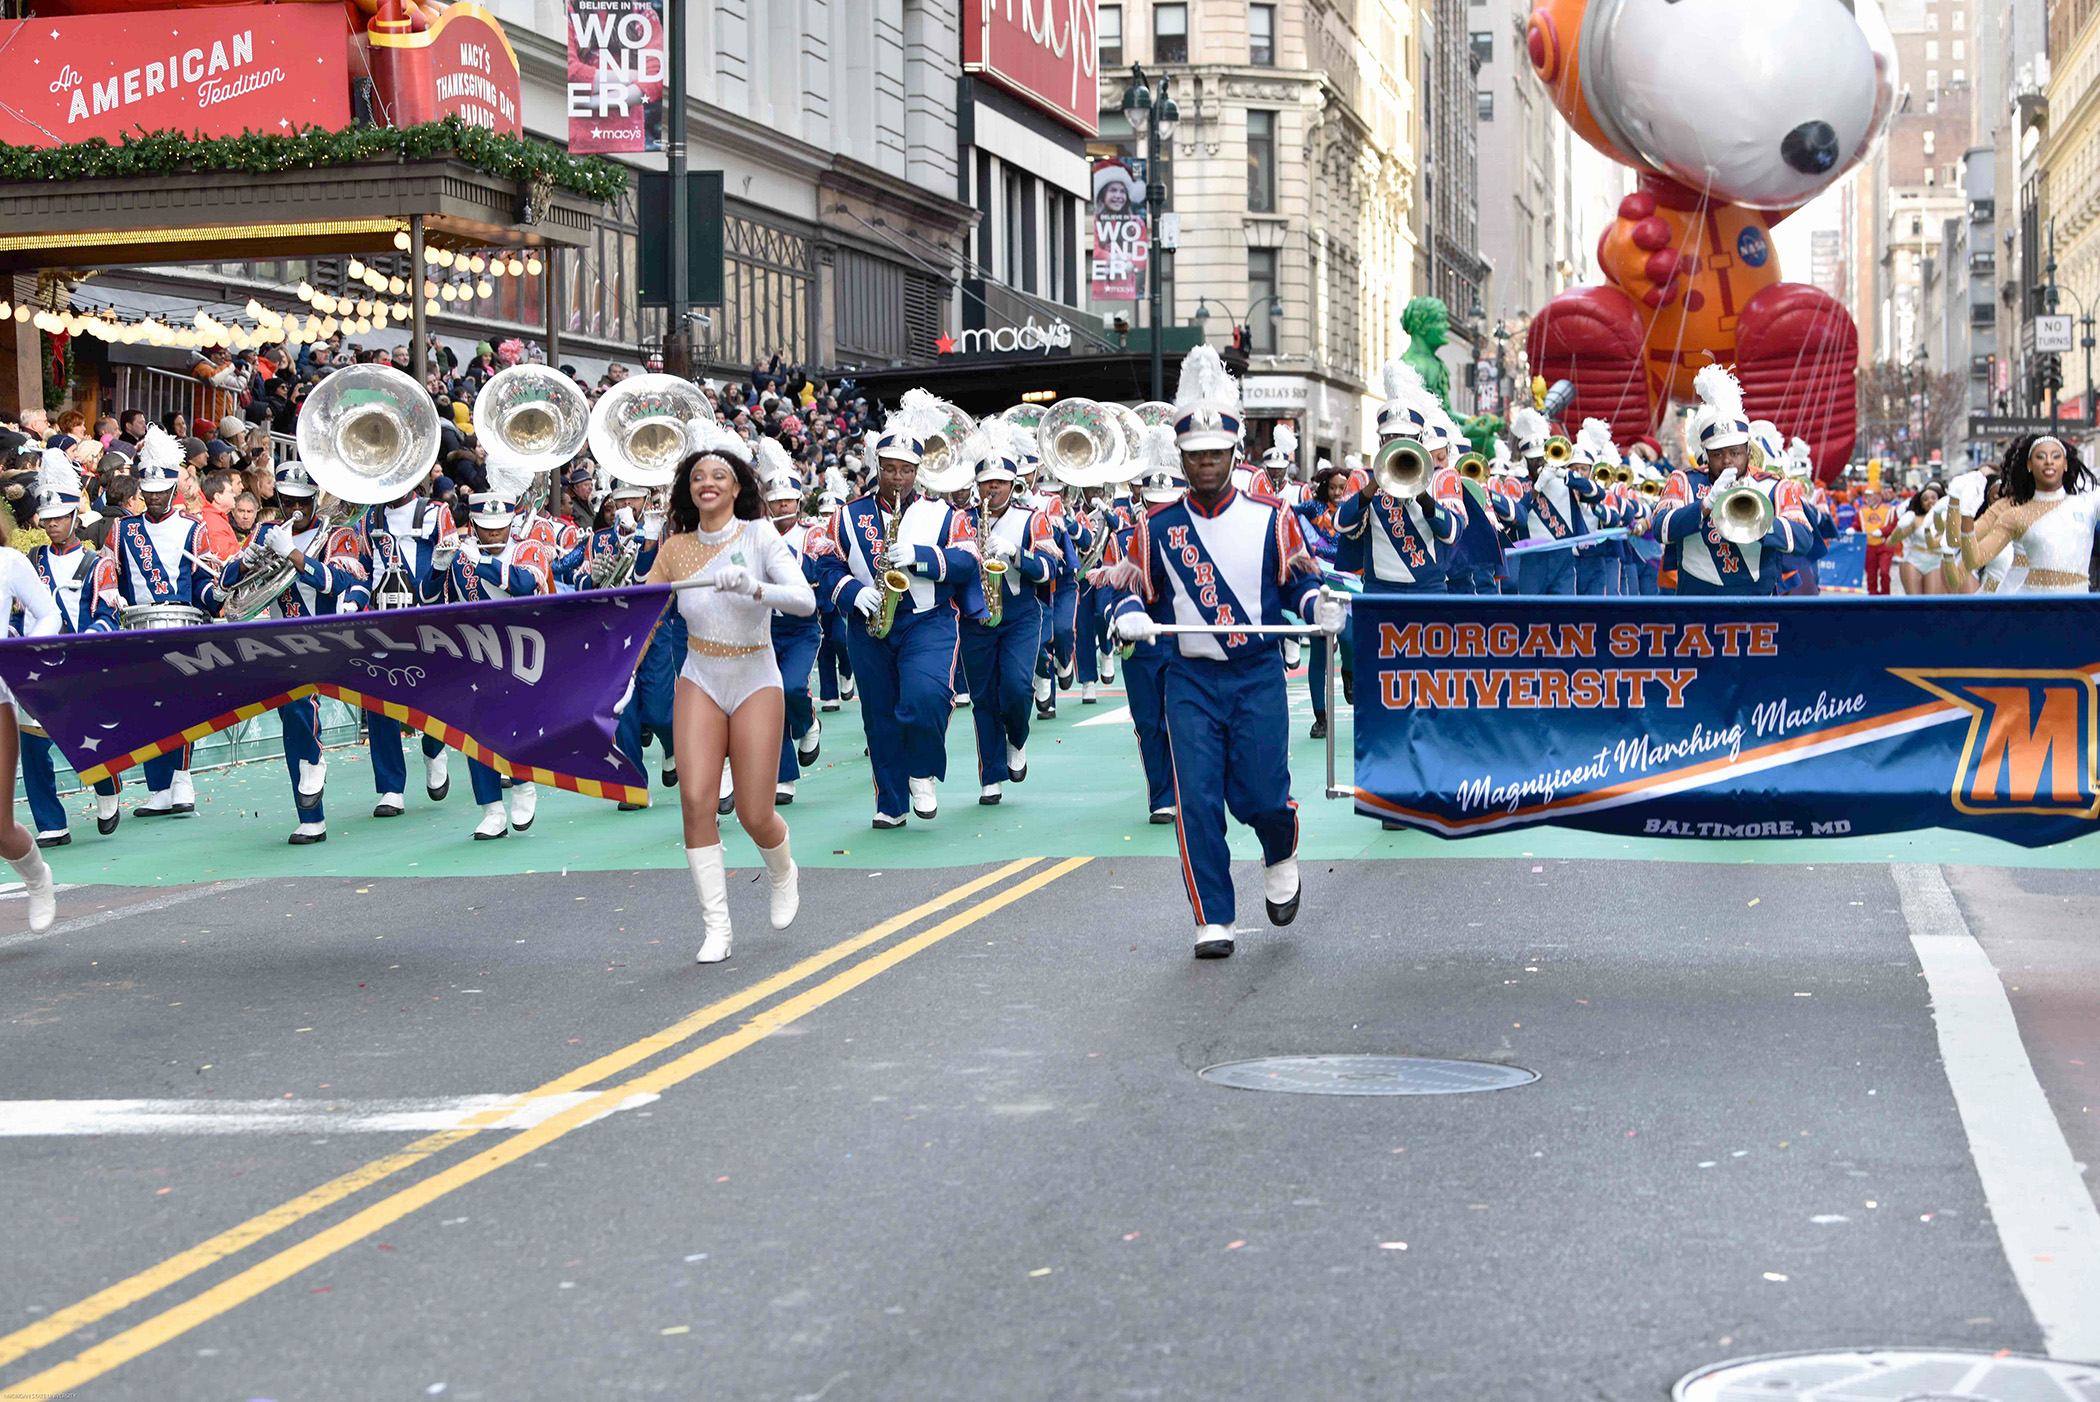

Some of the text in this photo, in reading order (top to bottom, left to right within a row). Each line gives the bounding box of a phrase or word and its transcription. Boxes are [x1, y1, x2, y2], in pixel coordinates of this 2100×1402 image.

[579, 1, 652, 10] BELIEVE IN THE
[571, 13, 653, 50] WO
[67, 30, 254, 125] AMERICAN
[460, 43, 491, 75] MACY'S
[599, 48, 664, 83] ND
[50, 64, 83, 93] An
[197, 67, 287, 108] Tradition
[436, 72, 516, 125] THANKSGIVING DAY
[460, 103, 495, 131] PARADE
[567, 83, 630, 118] ER
[602, 126, 641, 141] macy's
[1096, 221, 1142, 242] WO
[1110, 241, 1148, 261] ND
[1092, 259, 1129, 281] ER
[961, 316, 1072, 357] macy's
[2039, 337, 2070, 346] TURNS
[2044, 321, 2062, 332] NO
[1246, 387, 1289, 399] TORIA'S
[1537, 497, 1566, 537] RGAN
[1697, 484, 1739, 573] MGAN
[127, 523, 169, 595] MORGAN
[457, 551, 480, 602] MORG
[1168, 525, 1248, 648] MORGAN
[161, 624, 546, 687] MARYLAND
[1378, 622, 1779, 659] MORGAN STATE
[1378, 668, 1697, 709] UNIVERSITY
[1456, 690, 1867, 814] Magnificent Marching Machine
[1961, 686, 2084, 802] M
[1643, 818, 1852, 838] BALTIMORE, MD
